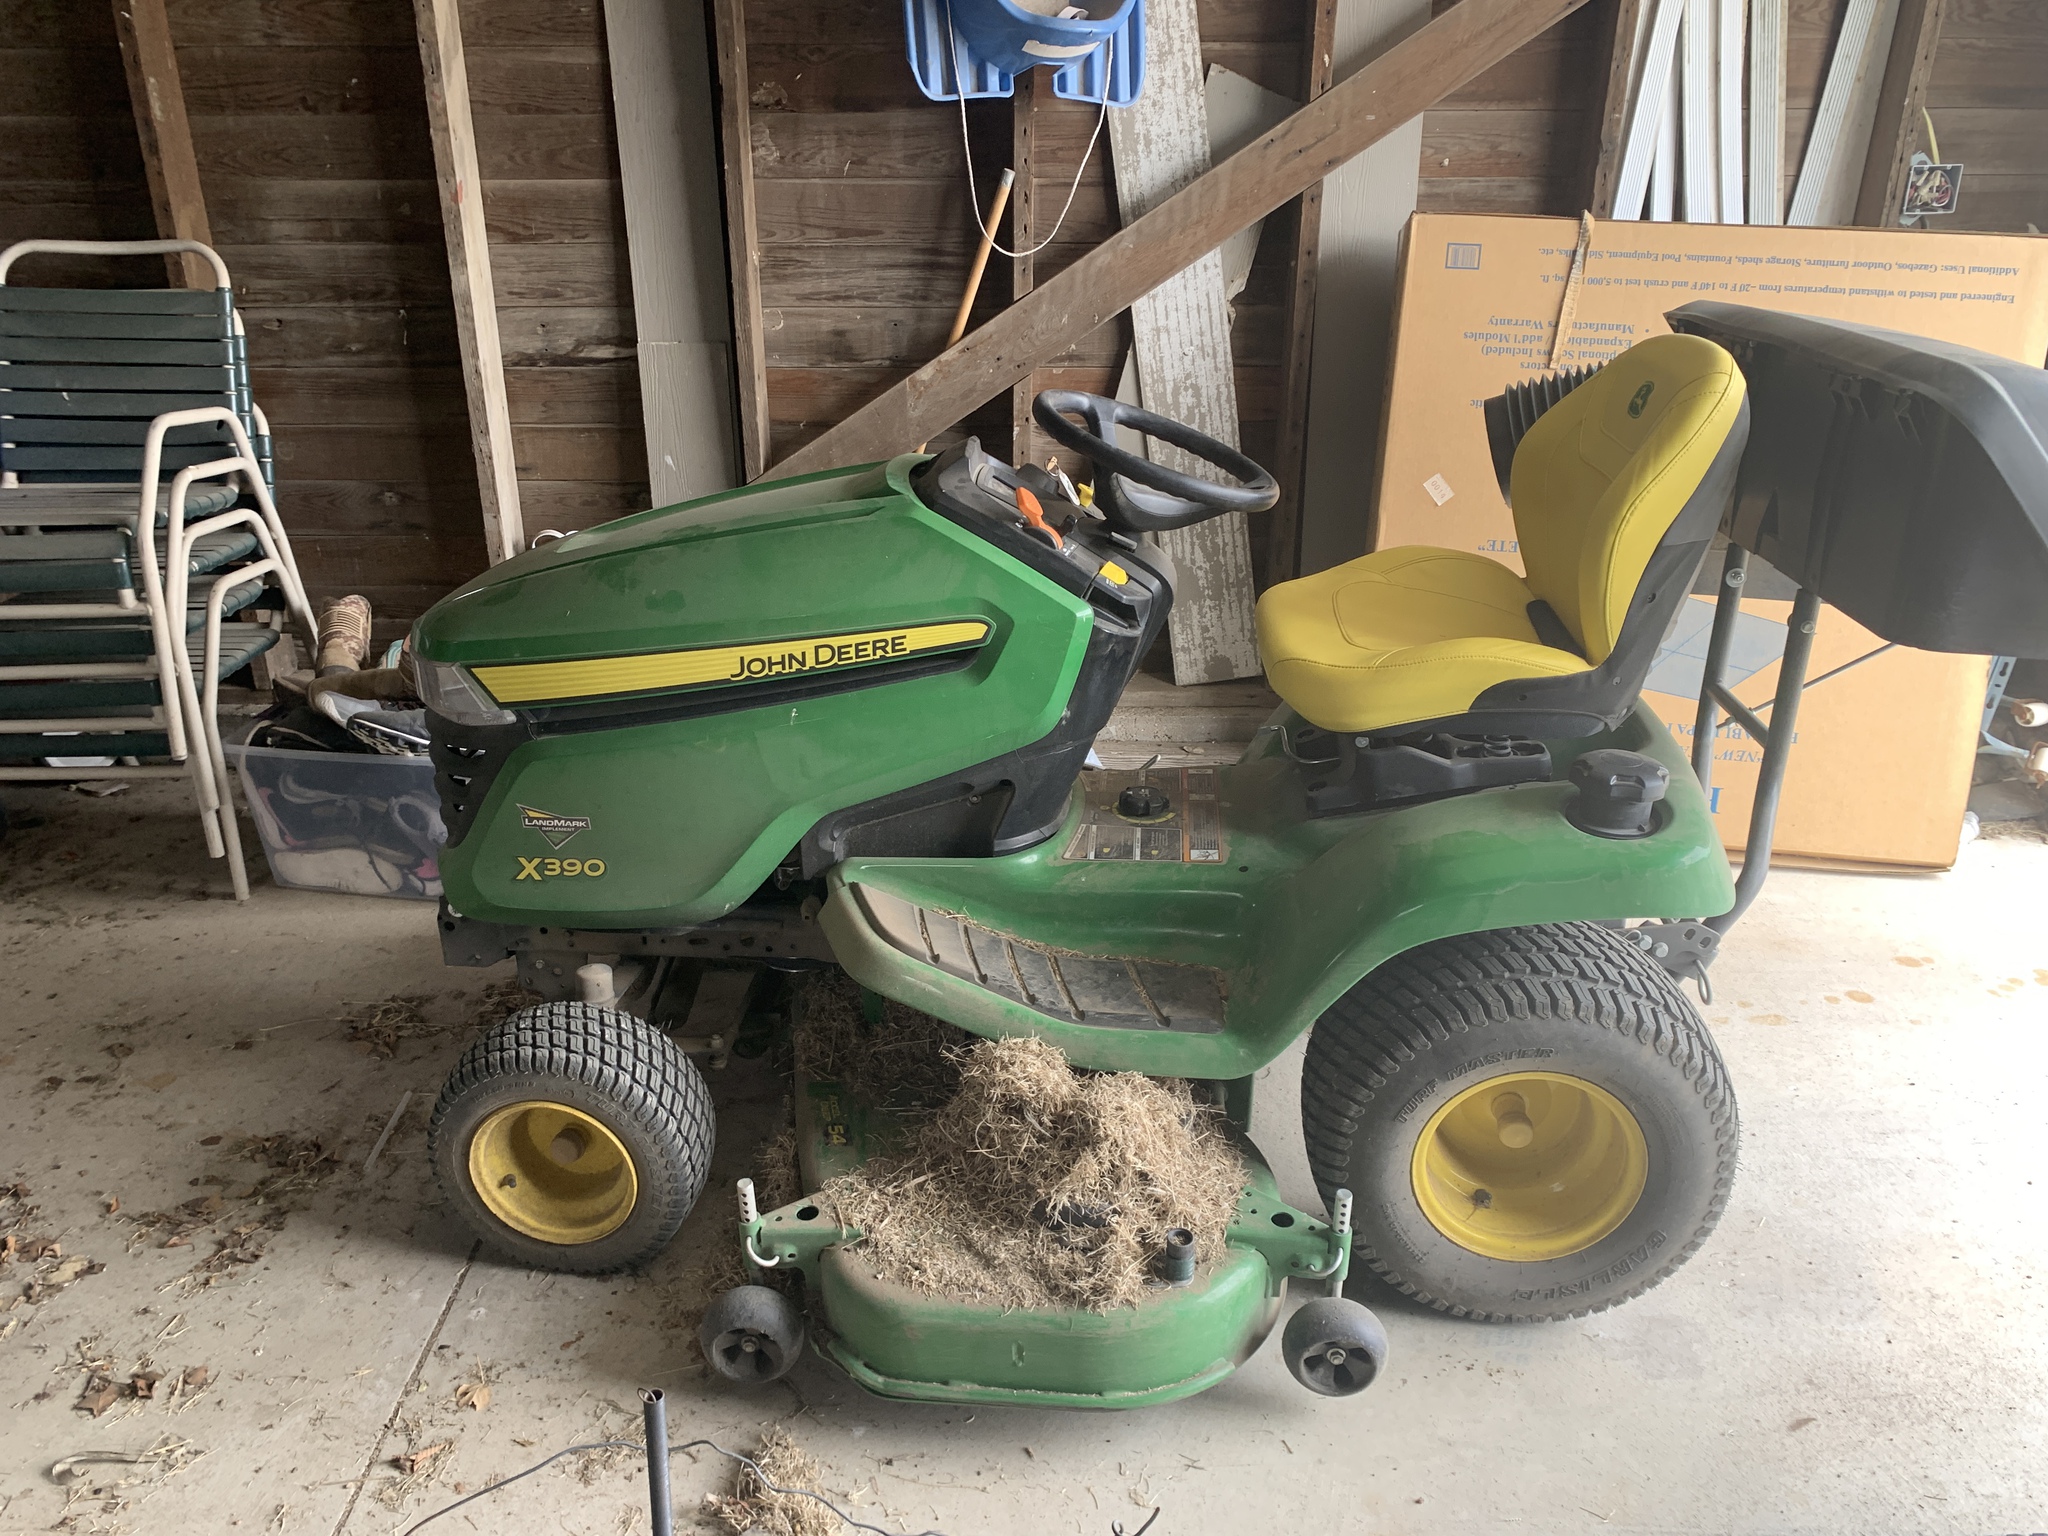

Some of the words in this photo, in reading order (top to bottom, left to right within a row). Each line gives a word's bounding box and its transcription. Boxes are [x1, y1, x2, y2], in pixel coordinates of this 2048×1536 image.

[1538, 248, 1554, 256] etc.
[1606, 250, 1660, 261] Equipment,
[1662, 253, 1682, 262] Pool
[1684, 253, 1733, 264] Fountains,
[1735, 255, 1764, 265] sheds,
[1765, 256, 1801, 267] Storage
[1804, 258, 1850, 269] furniture,
[1852, 260, 1893, 271] Outdoor
[1895, 261, 1938, 273] Gazebos,
[1941, 264, 1966, 275] Uses:
[1968, 265, 2020, 276] Additional
[1540, 275, 1550, 284] ft.
[1587, 277, 1612, 286] 5,000
[1613, 278, 1623, 286] to
[1625, 279, 1641, 287] test
[1643, 279, 1669, 288] crush
[1671, 280, 1689, 289] and
[1690, 281, 1698, 290] F
[1719, 282, 1729, 291] to
[1730, 283, 1738, 292] F
[1759, 284, 1781, 293] from
[1784, 285, 1847, 296] temperatures
[1848, 288, 1895, 298] withstand
[1897, 290, 1907, 298] to
[1909, 290, 1937, 300] tested
[1939, 291, 1958, 301] and
[1960, 292, 2015, 304] Engineered
[1488, 315, 1544, 329] Warranty
[1463, 331, 1511, 343] Modules
[1481, 345, 1533, 357] Included)
[730, 651, 807, 679] JOHN
[814, 635, 908, 666] DEERE
[515, 856, 606, 881] X390
[1394, 1078, 1438, 1123] TURF
[1446, 1047, 1555, 1081] MASTER
[585, 1091, 639, 1129] TURF
[828, 1124, 847, 1145] 54
[1512, 1229, 1668, 1301] CARLISLE
